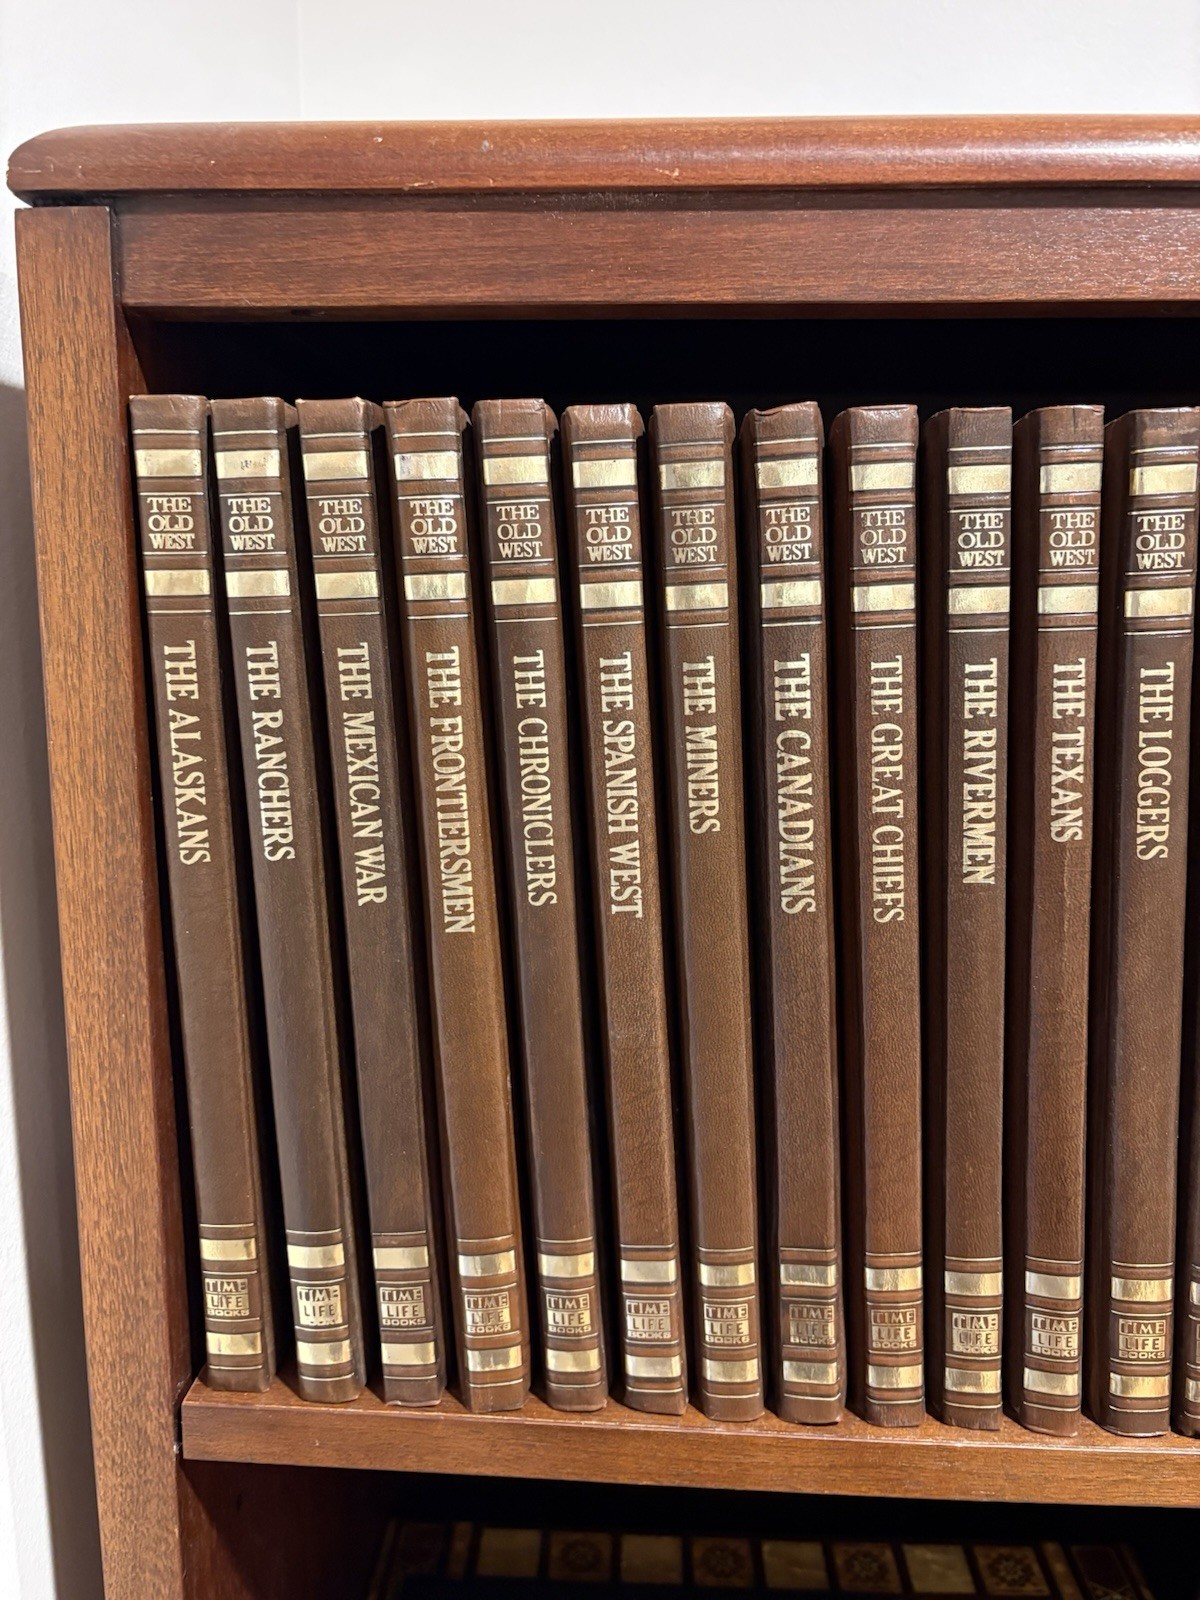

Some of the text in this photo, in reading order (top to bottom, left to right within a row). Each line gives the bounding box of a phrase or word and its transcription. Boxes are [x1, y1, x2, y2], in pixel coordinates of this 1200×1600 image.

[147, 497, 191, 513] THE
[228, 497, 270, 513] THE
[319, 500, 362, 515] THE
[410, 500, 454, 516] THE
[496, 505, 539, 520] THE
[585, 507, 628, 523] THE
[671, 510, 714, 526] THE
[766, 507, 810, 523] THE
[861, 511, 904, 526] THE
[959, 513, 1003, 528] THE
[1051, 513, 1094, 528] THE
[1137, 514, 1185, 531] THE
[148, 515, 193, 532] OLD
[229, 515, 273, 532] OLD
[319, 517, 365, 534] OLD
[410, 518, 457, 535] OLD
[497, 523, 541, 539] OLD
[149, 534, 194, 549] WEST
[230, 534, 275, 550] WEST
[586, 526, 631, 543] OLD
[671, 527, 717, 545] OLD
[765, 526, 811, 542] OLD
[861, 528, 906, 546] OLD
[958, 531, 1004, 548] OLD
[1050, 530, 1095, 547] OLD
[1136, 533, 1185, 550] OLD
[321, 536, 365, 552] WEST
[411, 536, 456, 553] WEST
[498, 542, 542, 558] WEST
[587, 544, 632, 560] WEST
[766, 544, 811, 560] WEST
[672, 546, 717, 563] WEST
[861, 547, 906, 564] WEST
[958, 550, 1004, 566] WEST
[1049, 550, 1095, 566] WEST
[1136, 552, 1185, 569] WEST
[164, 640, 211, 866] THE ALASKANS
[246, 641, 295, 862] THE RANCHERS
[682, 656, 720, 835] THE MINERS
[1050, 657, 1086, 843] THE TEXANS
[1136, 662, 1174, 861] THE LOGGERS
[337, 642, 388, 906] THE MEXICAN WAR
[513, 649, 557, 907] THE CHRONICLERS
[963, 657, 998, 885] THE RIVERMEN
[426, 646, 475, 933] THE FRONTIERSMEN
[600, 651, 642, 918] THE SPANISH WEST
[774, 653, 816, 915] THE CANADIANS
[870, 655, 904, 923] THE GREAT CHIEFS
[206, 1280, 248, 1293] TIME
[381, 1288, 423, 1301] TIME
[211, 1296, 243, 1308] LIFE
[299, 1288, 339, 1302] TIME
[466, 1294, 508, 1309] TIME
[548, 1296, 588, 1309] TIME
[304, 1304, 336, 1317] LIFE
[387, 1305, 419, 1317] LIFE
[628, 1302, 669, 1315] TIME
[705, 1305, 747, 1319] TIME
[791, 1306, 832, 1320] TIME
[471, 1311, 504, 1324] LIFE
[553, 1312, 585, 1325] LIFE
[632, 1318, 664, 1329] LIFE
[873, 1311, 914, 1324] TIME
[954, 1315, 997, 1329] TIME
[1033, 1316, 1077, 1332] TIME
[711, 1323, 743, 1335] LIFE
[796, 1323, 829, 1336] LIFE
[877, 1327, 911, 1341] LIFE
[1121, 1322, 1164, 1335] TIME
[959, 1332, 992, 1344] LIFE
[1038, 1335, 1073, 1347] LIFE
[1126, 1338, 1159, 1350] LIFE
